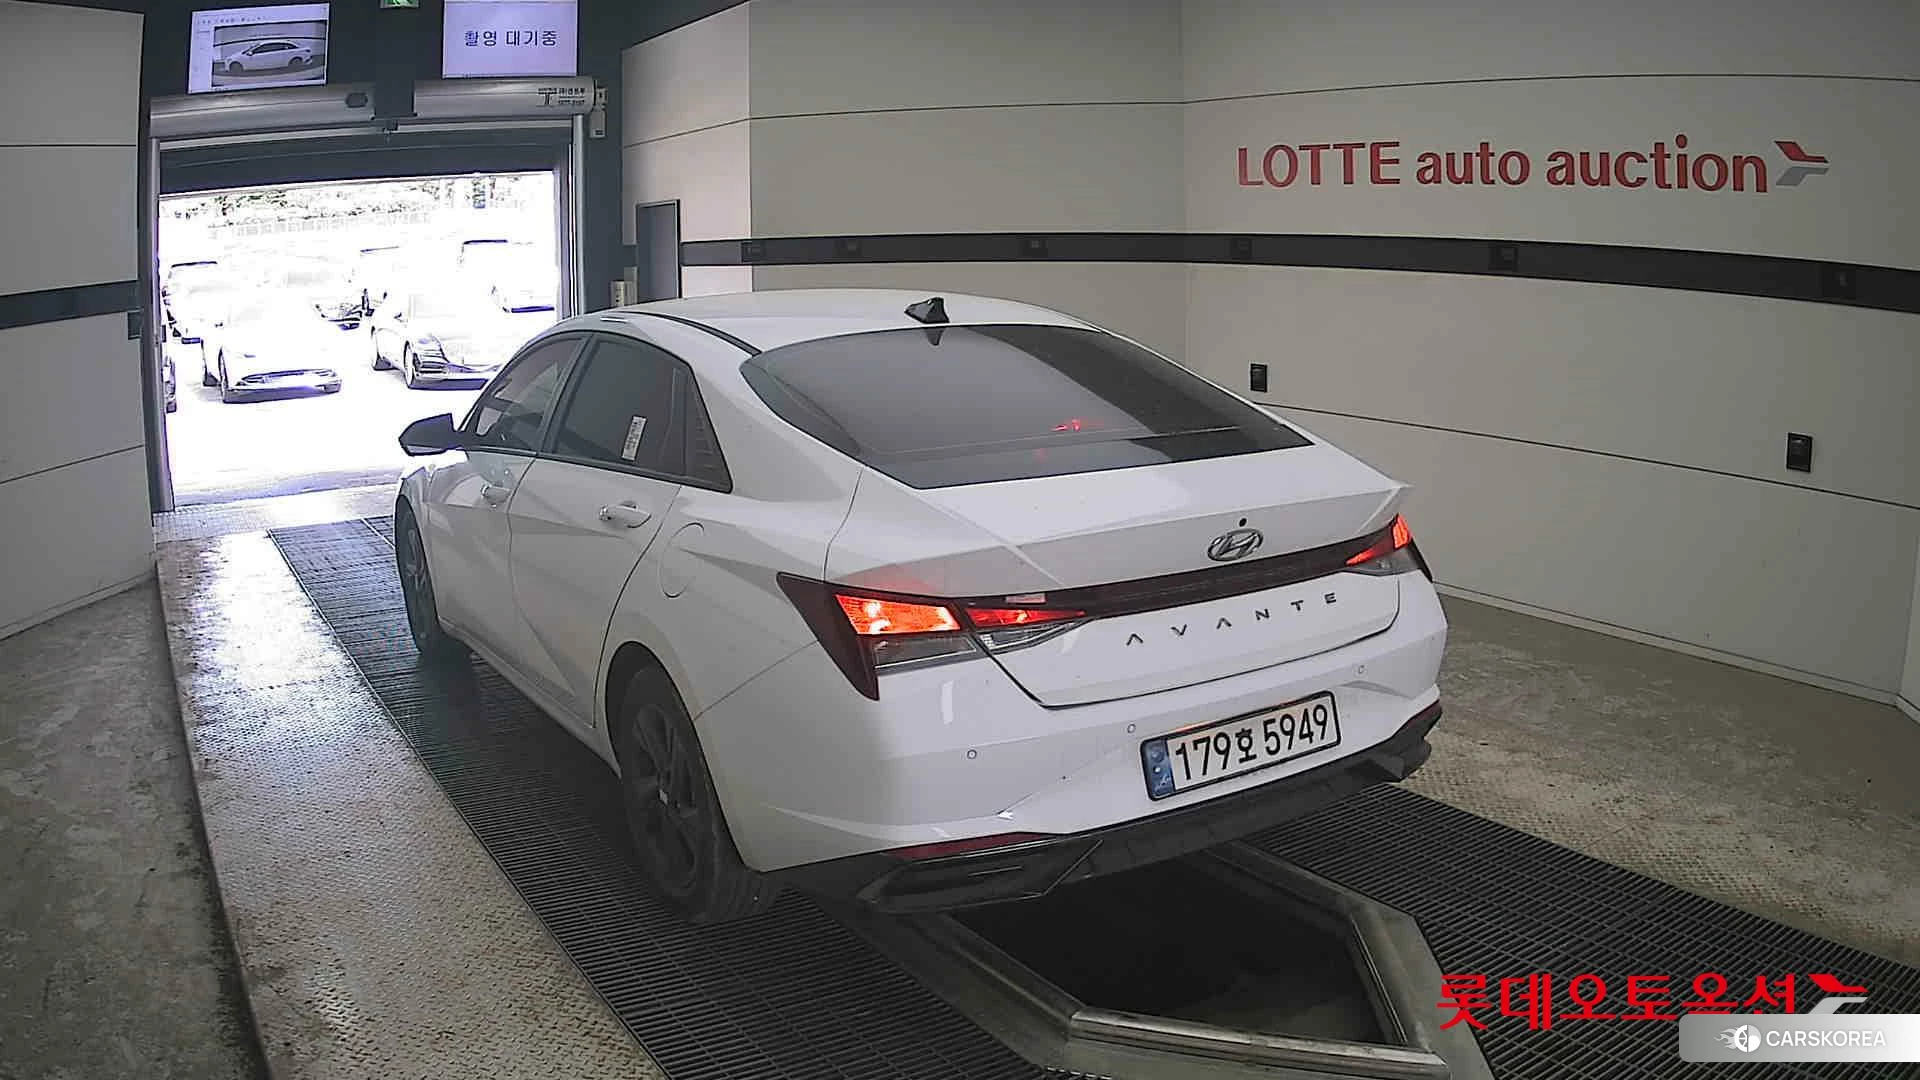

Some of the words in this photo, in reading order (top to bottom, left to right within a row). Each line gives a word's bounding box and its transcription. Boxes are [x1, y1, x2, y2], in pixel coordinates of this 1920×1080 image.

[465, 30, 497, 47] 촬영
[506, 30, 557, 47] 대기중
[1238, 141, 1400, 187] LOTTE
[1416, 142, 1531, 185] auto
[1546, 134, 1768, 193] auction
[1126, 592, 1337, 646] AVANTE
[1175, 728, 1257, 780] 179호
[1263, 704, 1328, 756] 5949
